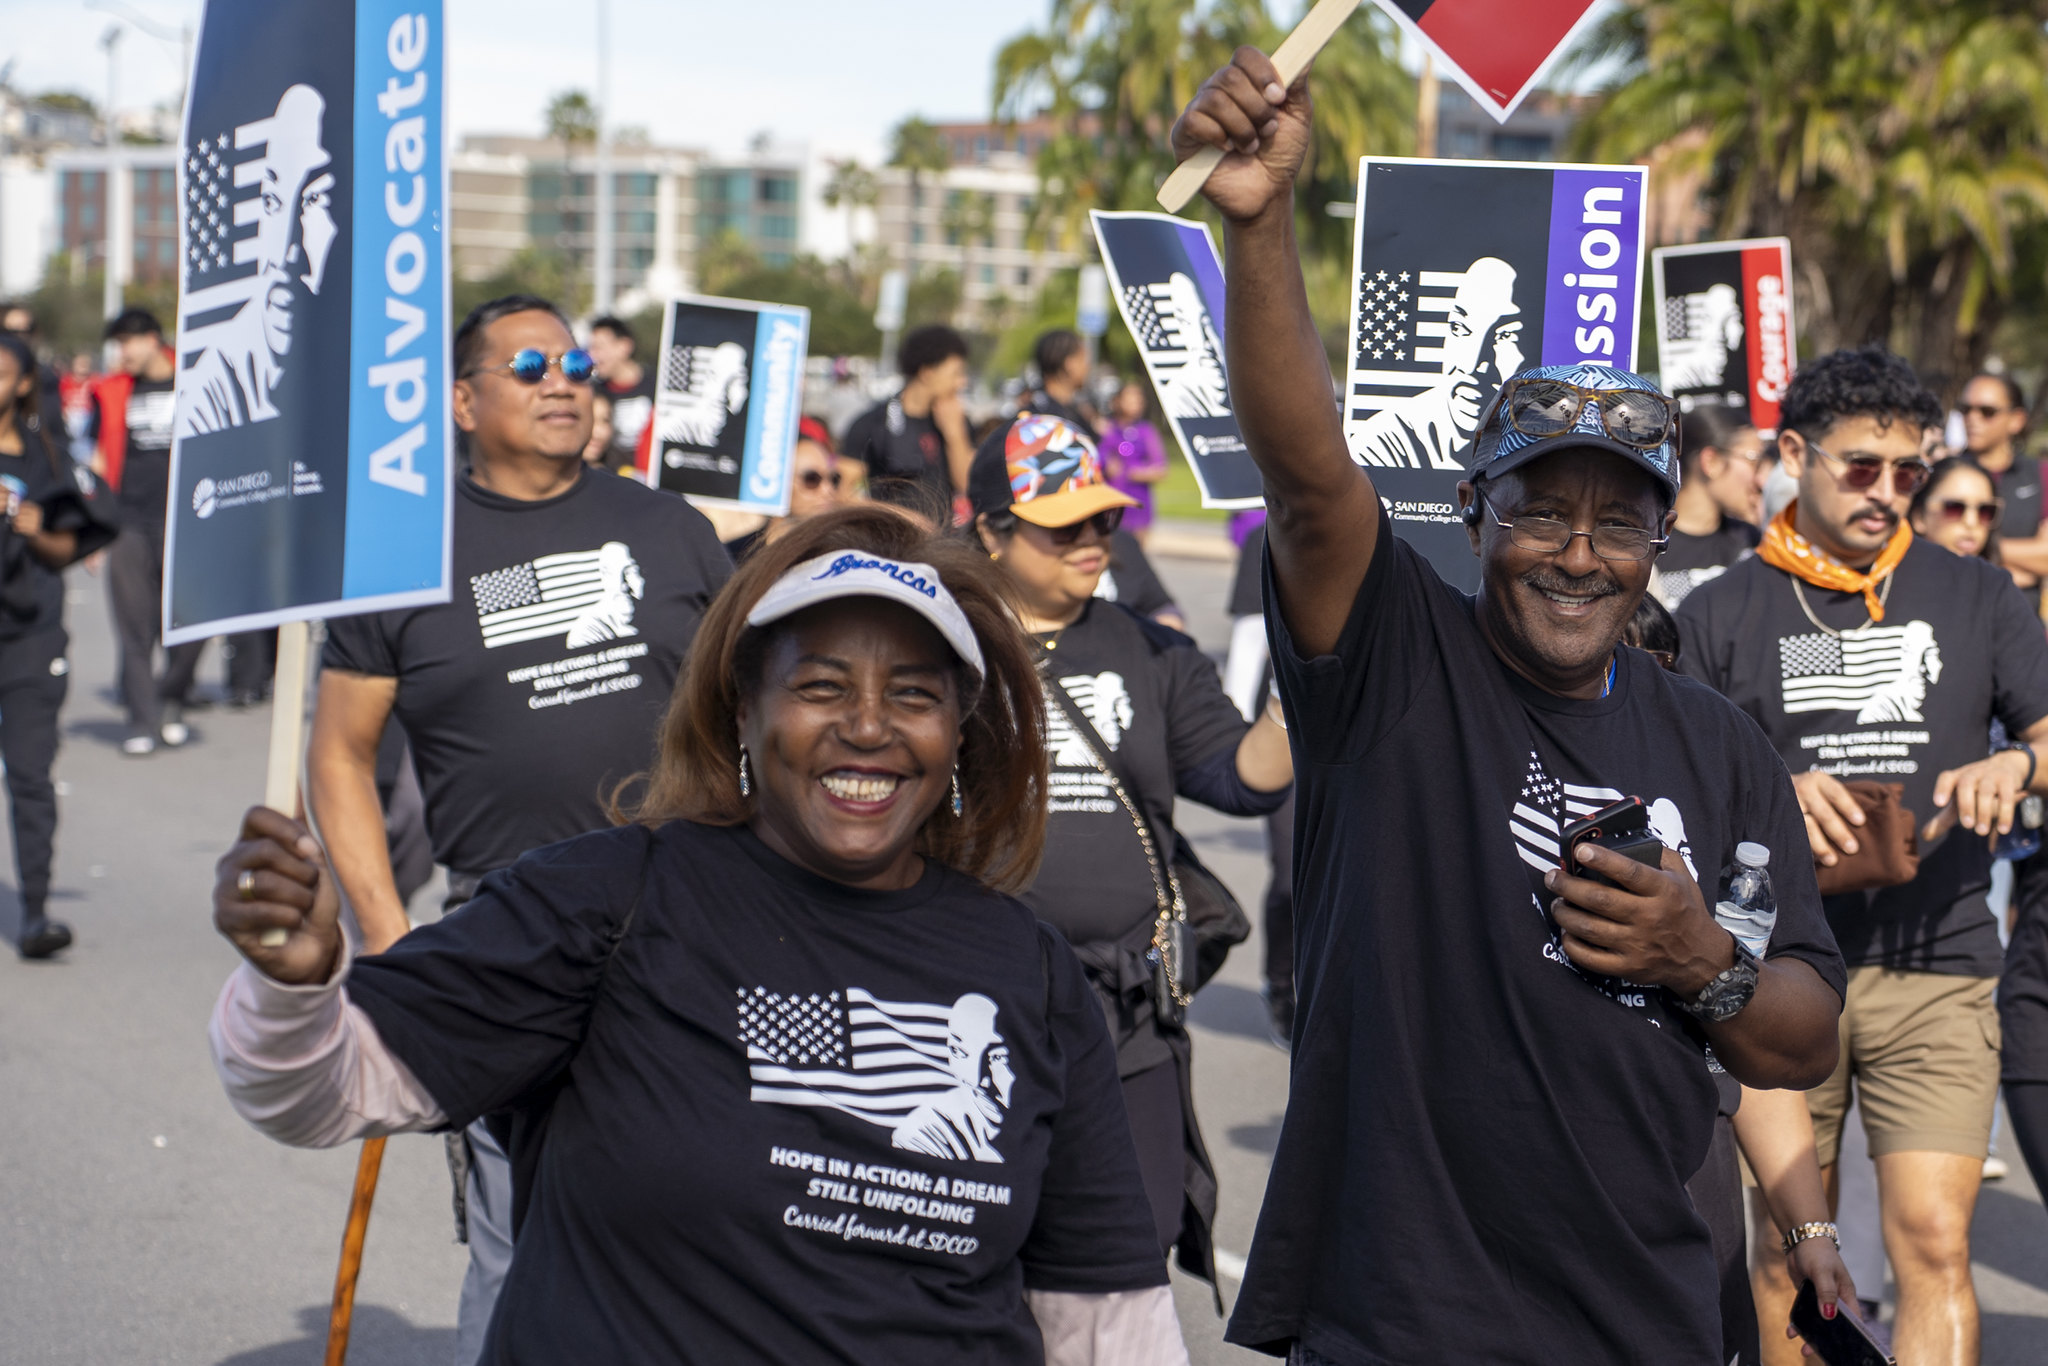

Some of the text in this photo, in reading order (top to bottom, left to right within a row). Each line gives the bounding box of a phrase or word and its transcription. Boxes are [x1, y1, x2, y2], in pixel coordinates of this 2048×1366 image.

[368, 13, 428, 497] Advocate
[1757, 275, 1790, 402] Courage
[751, 319, 802, 498] Community
[217, 470, 272, 496] SAN DIEGO
[1394, 501, 1453, 514] SAN DIEGO
[1394, 513, 1428, 523] Community
[1429, 513, 1452, 524] College
[507, 665, 539, 683] HOPE
[539, 662, 553, 676] IN
[597, 651, 606, 663] A
[606, 642, 649, 661] DREAM
[533, 660, 630, 691] STILL UNFOLDING
[1818, 744, 1909, 759] STILL UNFOLDING
[1882, 731, 1890, 743] A
[1890, 731, 1930, 744] DREAM
[769, 1146, 1011, 1205] HOPE IN ACTION: A DREAM
[807, 1178, 976, 1225] STILL UNFOLDING
[783, 1205, 979, 1256] Carried forward at SDCCD
